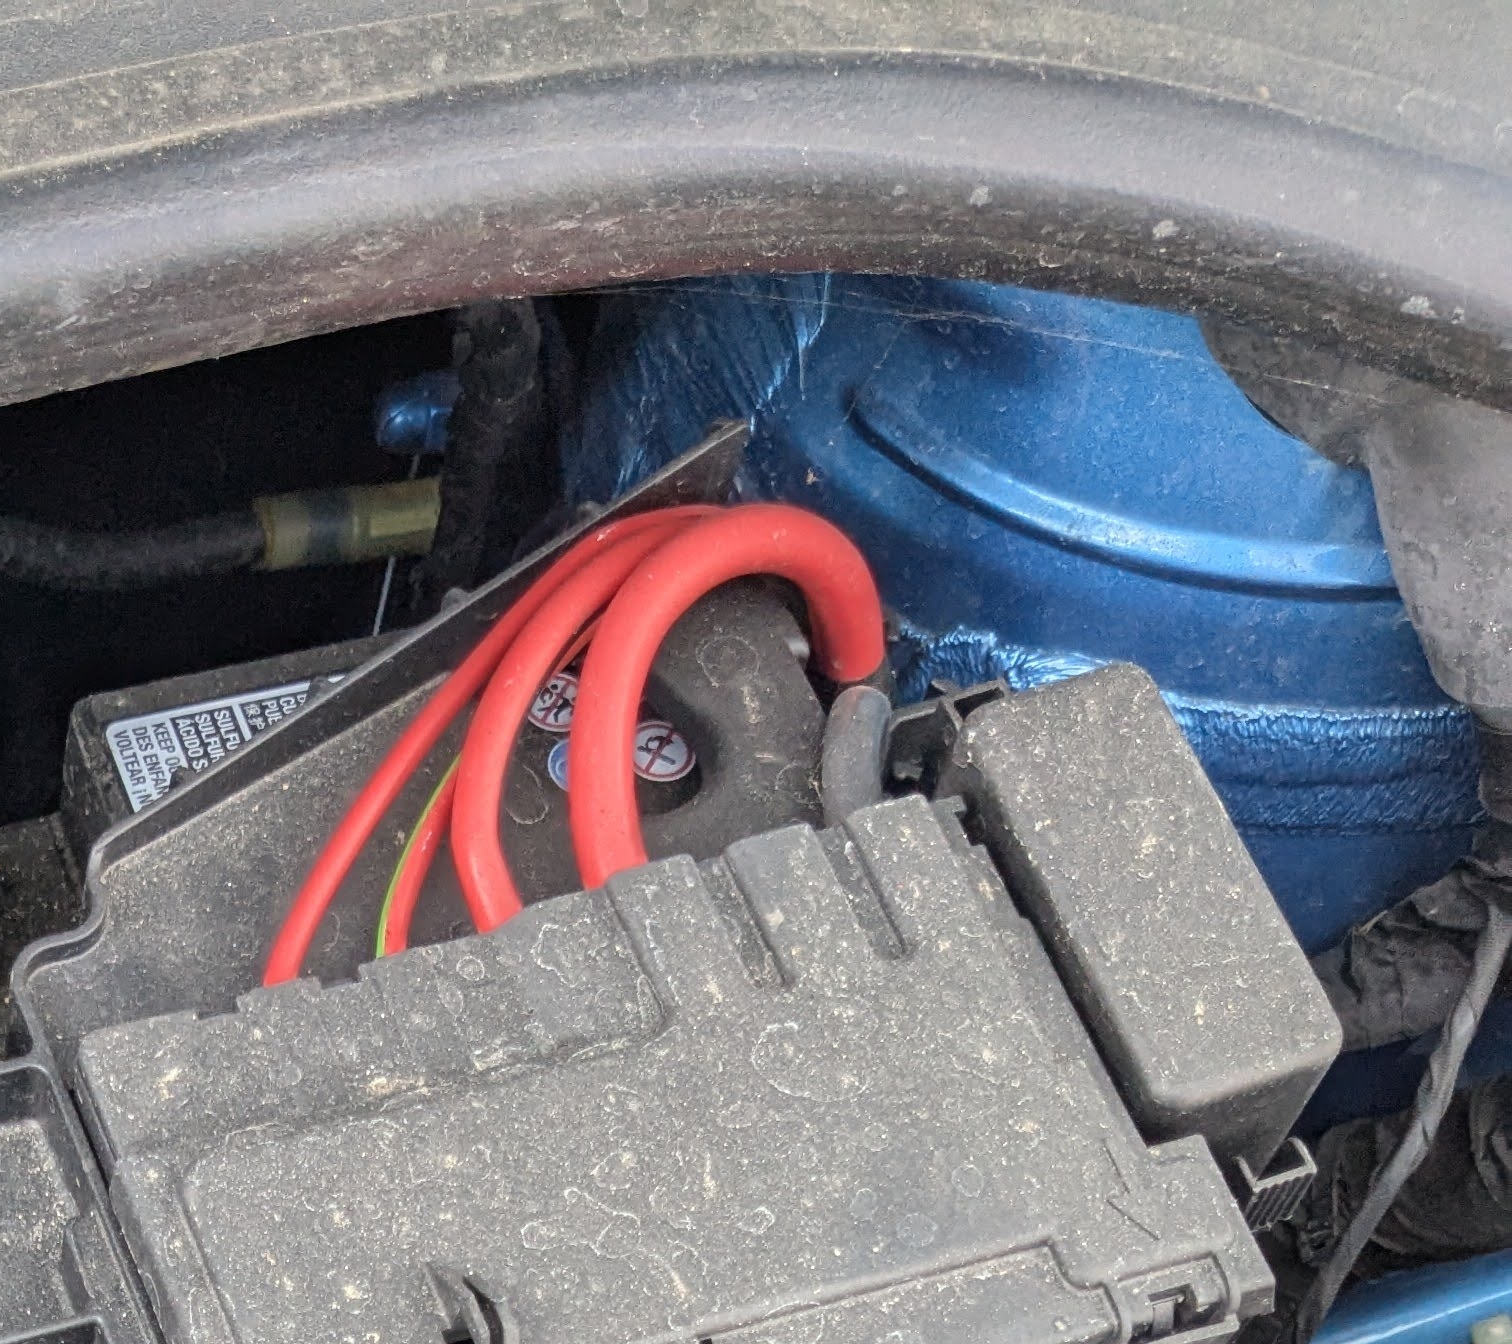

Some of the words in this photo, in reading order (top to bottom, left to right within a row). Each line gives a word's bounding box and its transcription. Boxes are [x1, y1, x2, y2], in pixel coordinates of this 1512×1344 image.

[131, 725, 154, 752] DES
[151, 721, 176, 755] KEEP
[174, 715, 204, 758] ÁCIDO
[113, 729, 146, 786] VOLTEAR
